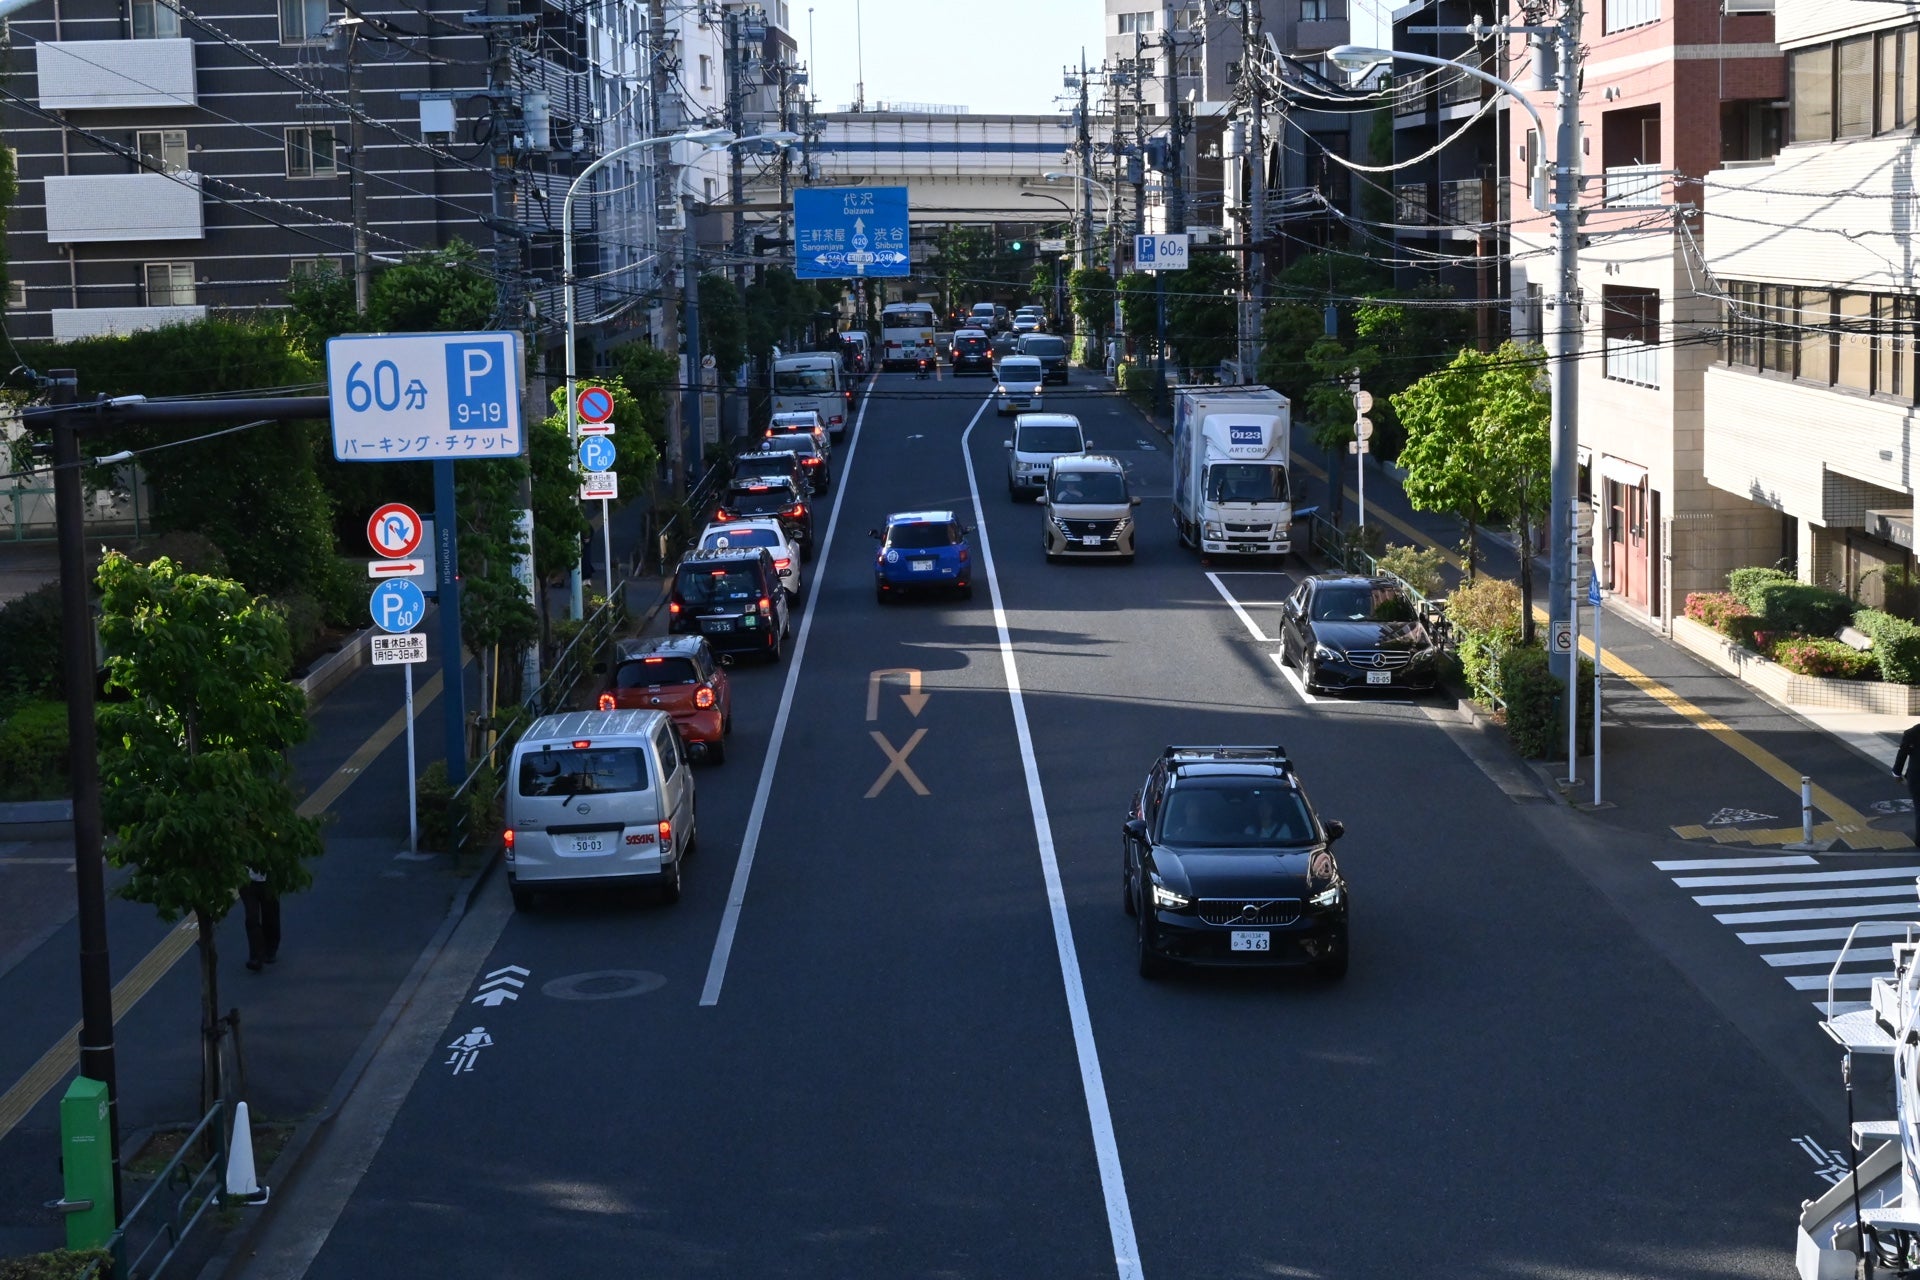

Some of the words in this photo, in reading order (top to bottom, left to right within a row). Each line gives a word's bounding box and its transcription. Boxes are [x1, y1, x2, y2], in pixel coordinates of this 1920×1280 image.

[844, 192, 873, 206] 代沢
[800, 229, 845, 242] 三軒茶屋
[873, 227, 904, 240] 渋谷
[802, 243, 844, 251] Sangenjaya
[875, 241, 903, 249] Shibuya
[1142, 238, 1152, 253] P
[464, 349, 493, 397] P
[346, 360, 428, 412] 60分
[457, 403, 501, 423] 9-19
[1231, 431, 1261, 440] 0123
[344, 433, 513, 454] パーキング・チケット
[587, 444, 601, 466] P
[443, 549, 451, 585] MISHUKU
[385, 582, 409, 591] 9-19
[382, 593, 404, 627] P
